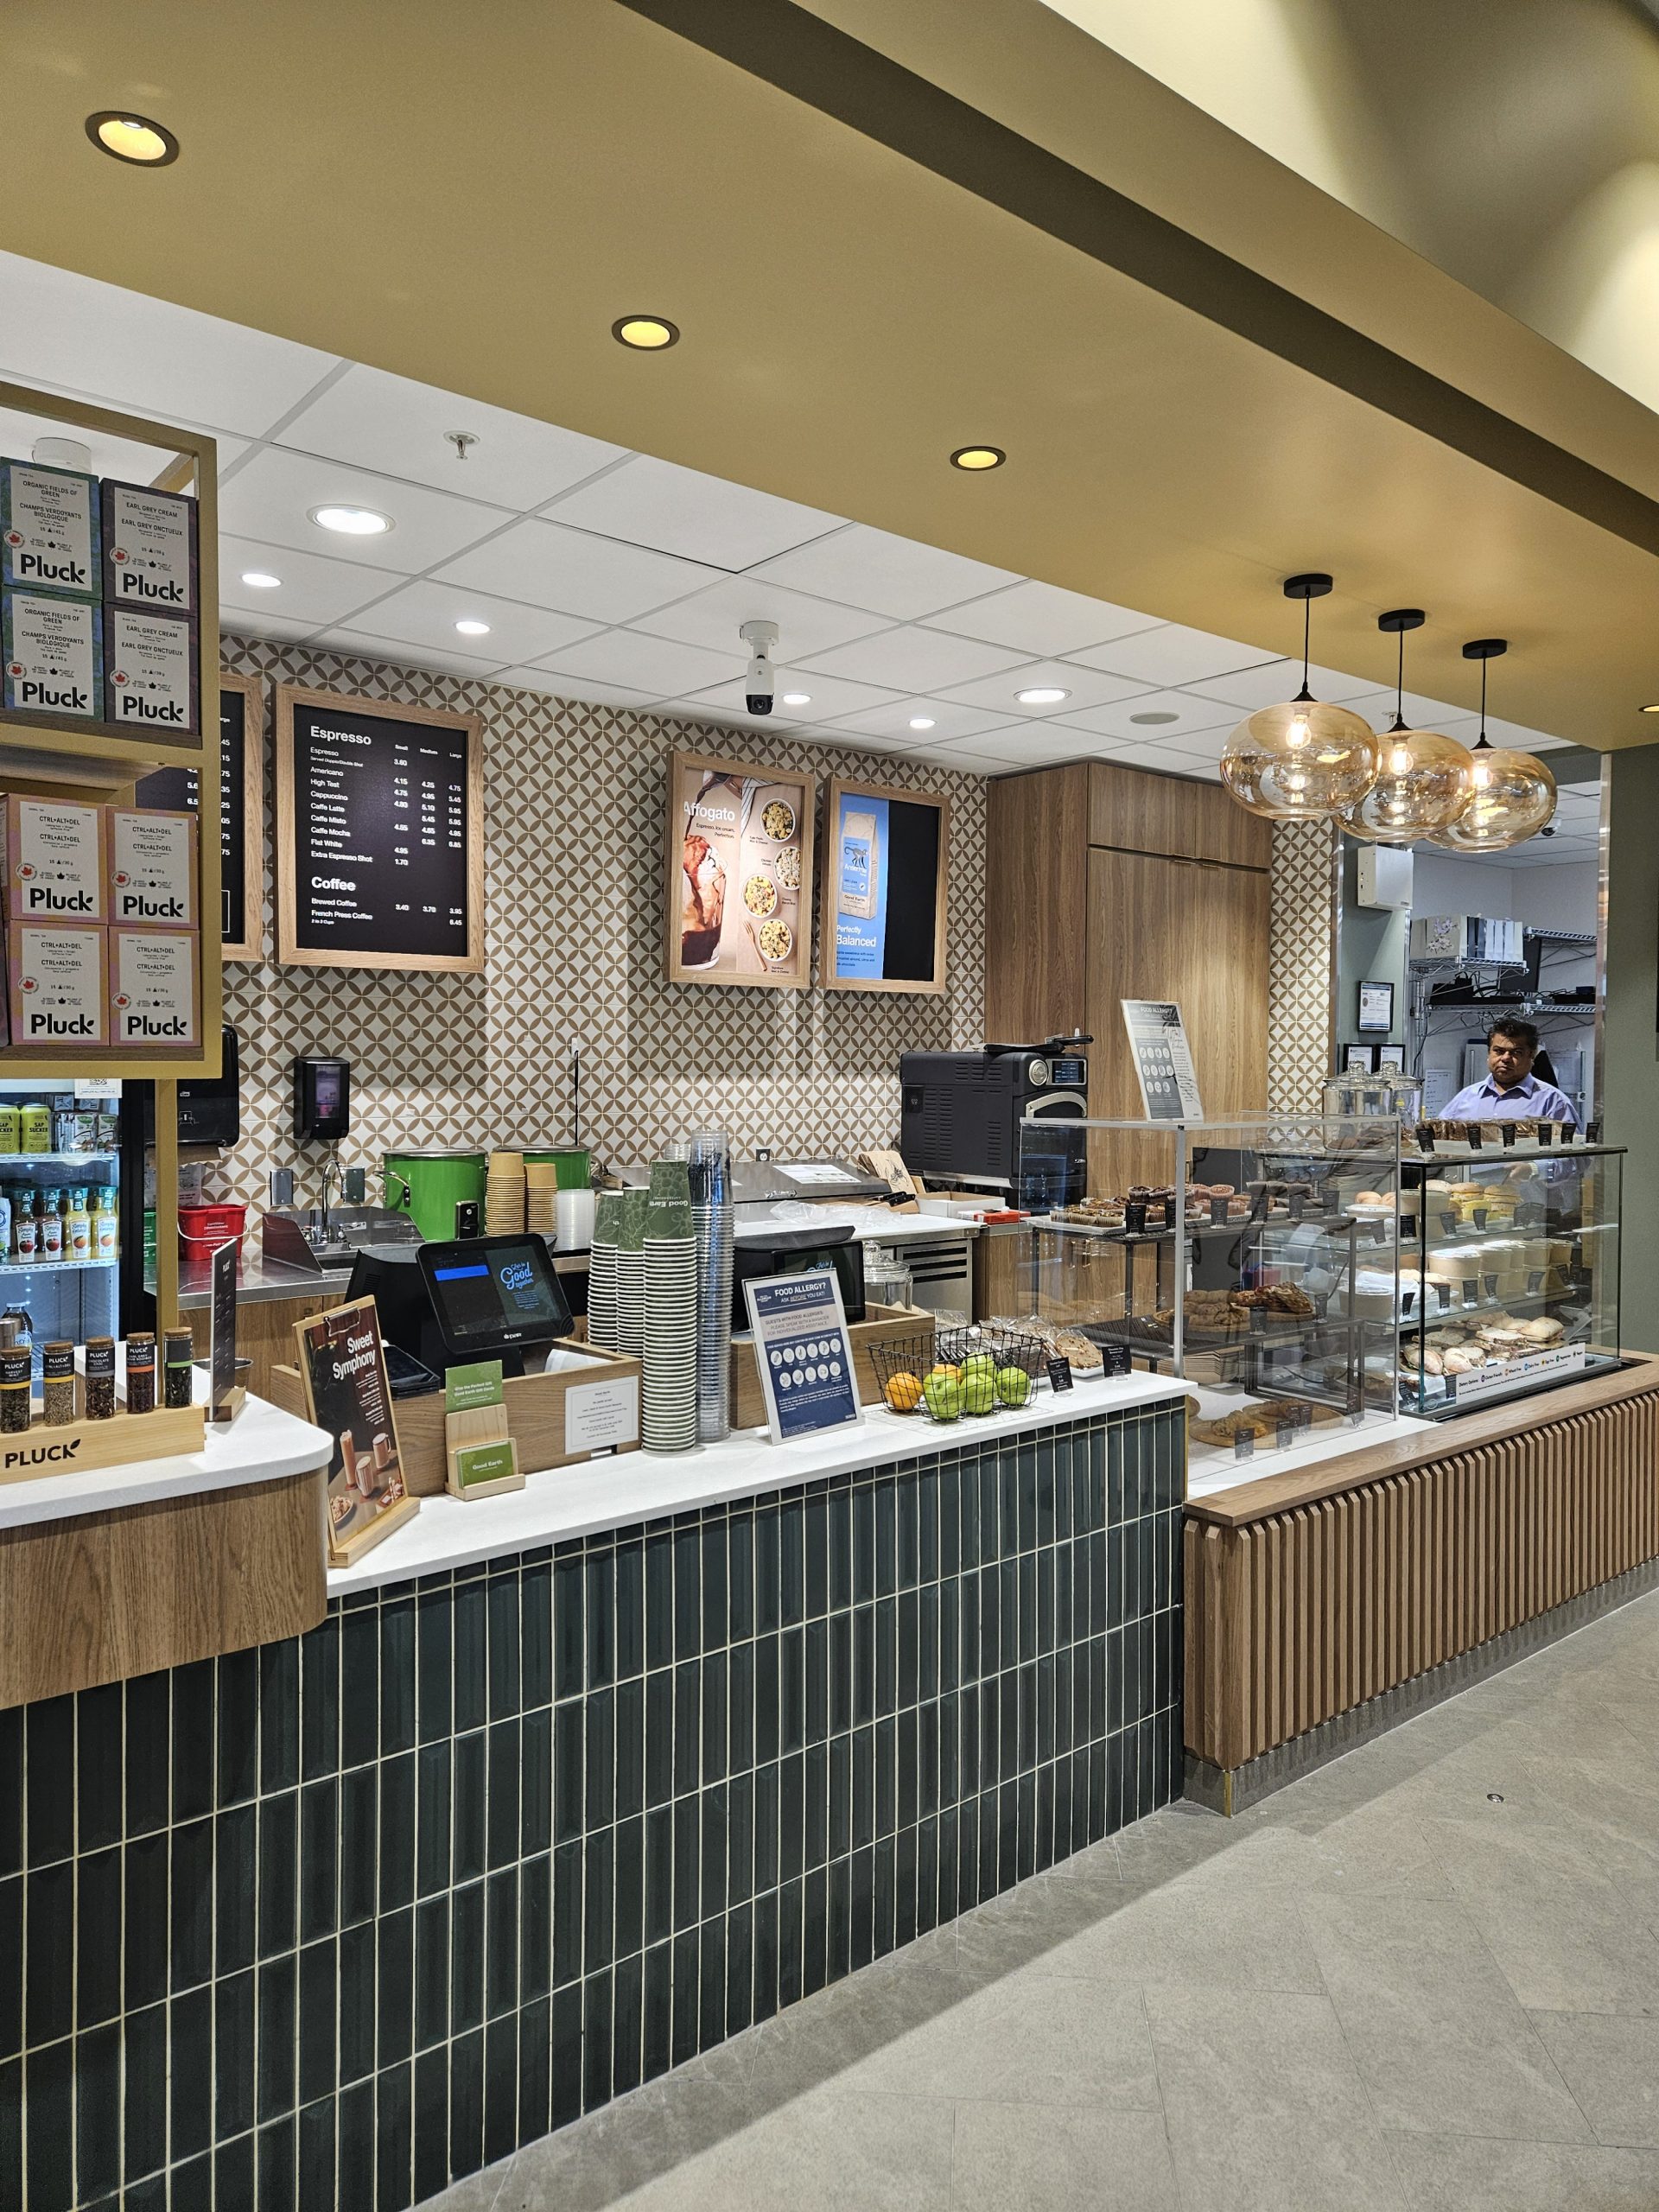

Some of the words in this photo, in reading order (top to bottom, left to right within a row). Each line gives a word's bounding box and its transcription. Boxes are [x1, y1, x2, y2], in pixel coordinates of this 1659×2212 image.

[23, 480, 48, 491] ORGANIC
[49, 486, 69, 495] FIELDS
[41, 490, 60, 499] GREEN
[20, 502, 45, 512] CHAMPS
[45, 507, 82, 519] VERDOYANTS
[126, 502, 142, 512] EARL
[142, 505, 157, 513] GREY
[158, 508, 178, 518] CREAM
[34, 512, 68, 523] BIOLOGIQUE
[121, 518, 137, 527] EARL
[137, 521, 152, 530] GREY
[153, 524, 183, 537] ONCTUEUX
[20, 553, 86, 584] Pluck
[123, 572, 184, 603] Pluck
[24, 608, 51, 618] ORGANIC
[52, 613, 71, 621] FIELDS
[43, 616, 62, 625] GREEN
[22, 631, 47, 639] CHAMPS
[48, 633, 85, 645] VERDOYANTS
[126, 625, 142, 633] EARL
[158, 630, 178, 639] CREAM
[35, 639, 71, 649] BIOLOGIQUE
[153, 646, 183, 657] ONCTUEUX
[22, 681, 87, 709] Pluck
[123, 695, 184, 722] Pluck
[311, 725, 372, 745] Espresso
[310, 747, 339, 757] Espresso
[310, 766, 344, 777] Americano
[310, 779, 326, 787] High
[310, 791, 348, 801] Cappuccino
[329, 804, 346, 813] Latte
[683, 801, 735, 822] Affogato
[329, 829, 352, 837] Mocha
[324, 840, 343, 849] White
[328, 852, 357, 861] Espresso
[358, 855, 373, 863] Shot
[311, 876, 357, 892] Coffee
[29, 887, 93, 912] Pluck
[123, 895, 184, 918] Pluck
[311, 897, 335, 906] Brewed
[311, 909, 334, 918] French
[836, 925, 862, 935] Perfectly
[836, 934, 877, 948] Balanced
[30, 1013, 95, 1035] Pluck
[127, 1014, 188, 1036] Pluck
[500, 1261, 533, 1290] Good
[774, 1287, 793, 1297] FOOD
[794, 1281, 827, 1294] ALLERGY?
[346, 1330, 374, 1354] Sweet
[4, 1361, 25, 1370] PLUCK
[332, 1349, 376, 1381] Symphony
[5, 1439, 81, 1469] PLUCK
[472, 1461, 488, 1471] Good
[487, 1459, 503, 1467] Earth
